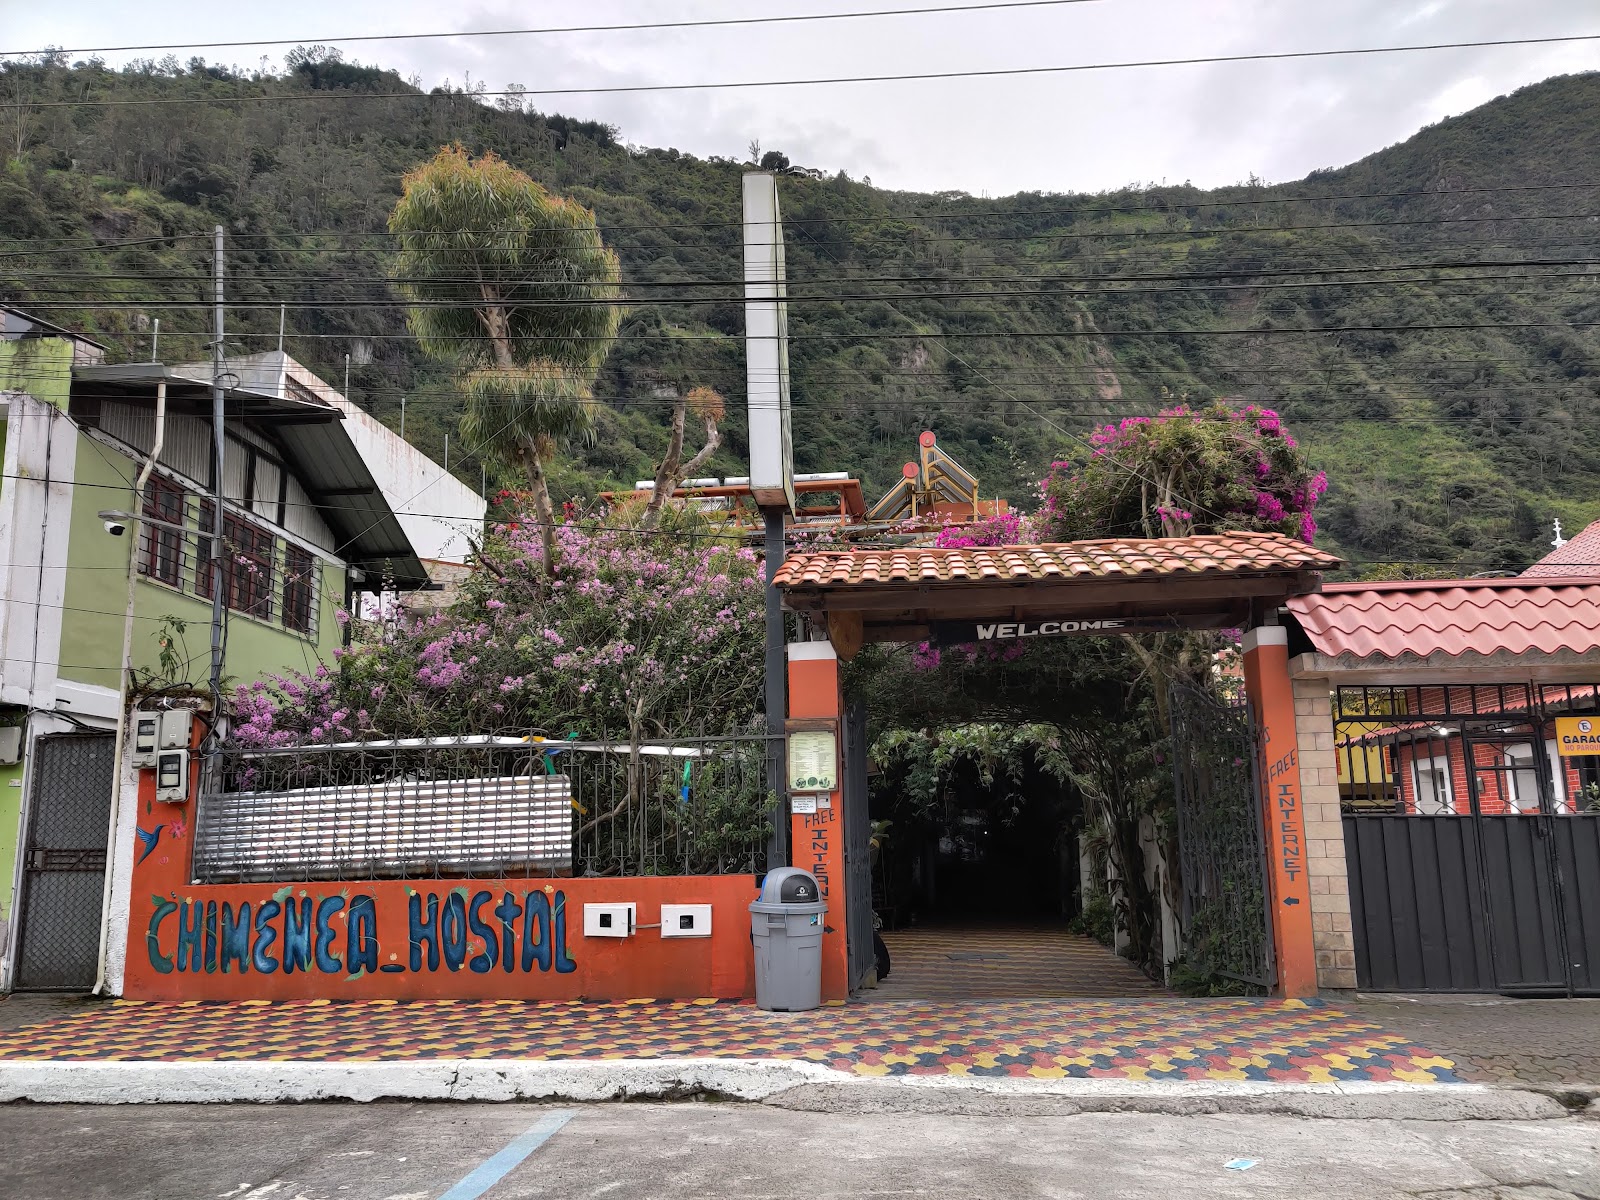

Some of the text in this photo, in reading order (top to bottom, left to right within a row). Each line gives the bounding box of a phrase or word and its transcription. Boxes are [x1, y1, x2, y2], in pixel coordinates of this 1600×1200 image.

[976, 620, 1126, 640] WELCOME
[1269, 748, 1296, 782] FREE
[805, 809, 836, 829] FREE
[1277, 784, 1301, 882] INTERNET
[811, 829, 829, 901] INTERN
